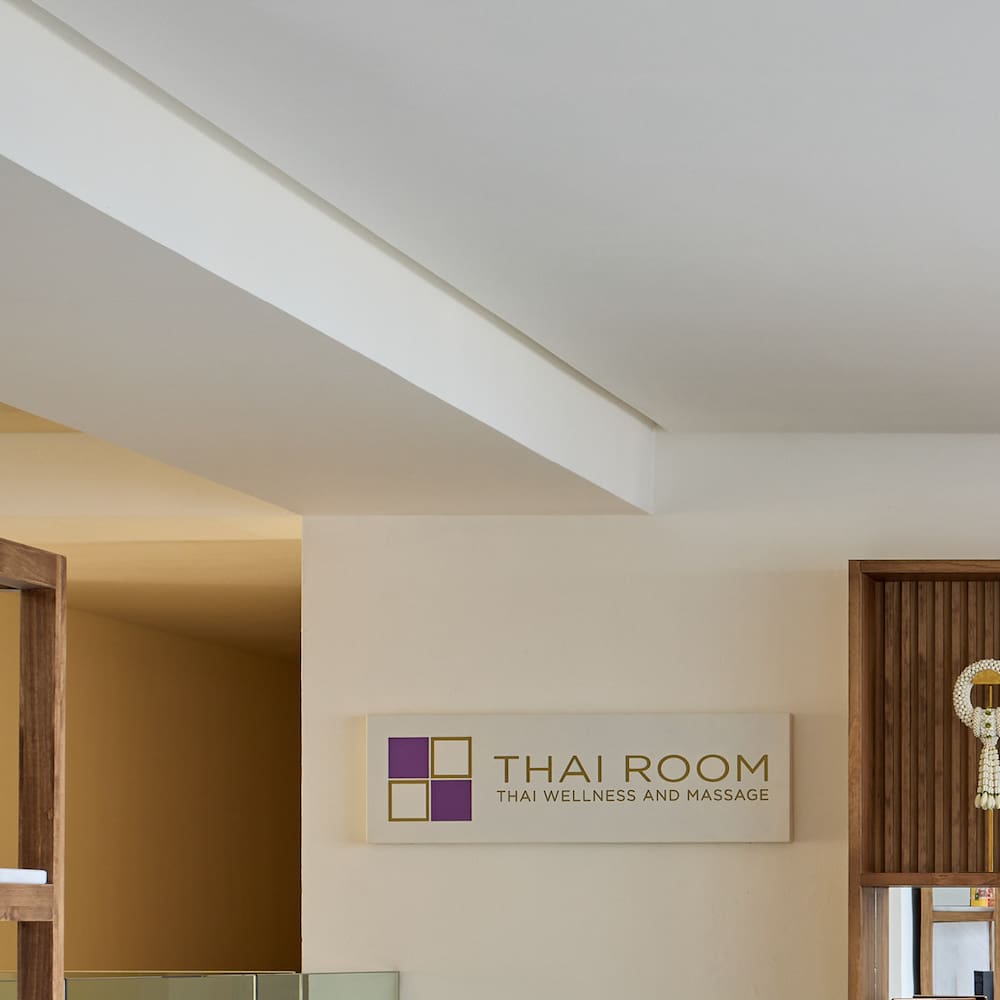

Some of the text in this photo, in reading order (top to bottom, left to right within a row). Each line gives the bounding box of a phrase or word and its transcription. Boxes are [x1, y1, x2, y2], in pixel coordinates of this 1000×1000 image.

[494, 754, 769, 784] THAI ROOM
[497, 788, 770, 803] THAI WELLNESS AND MASSAGE
